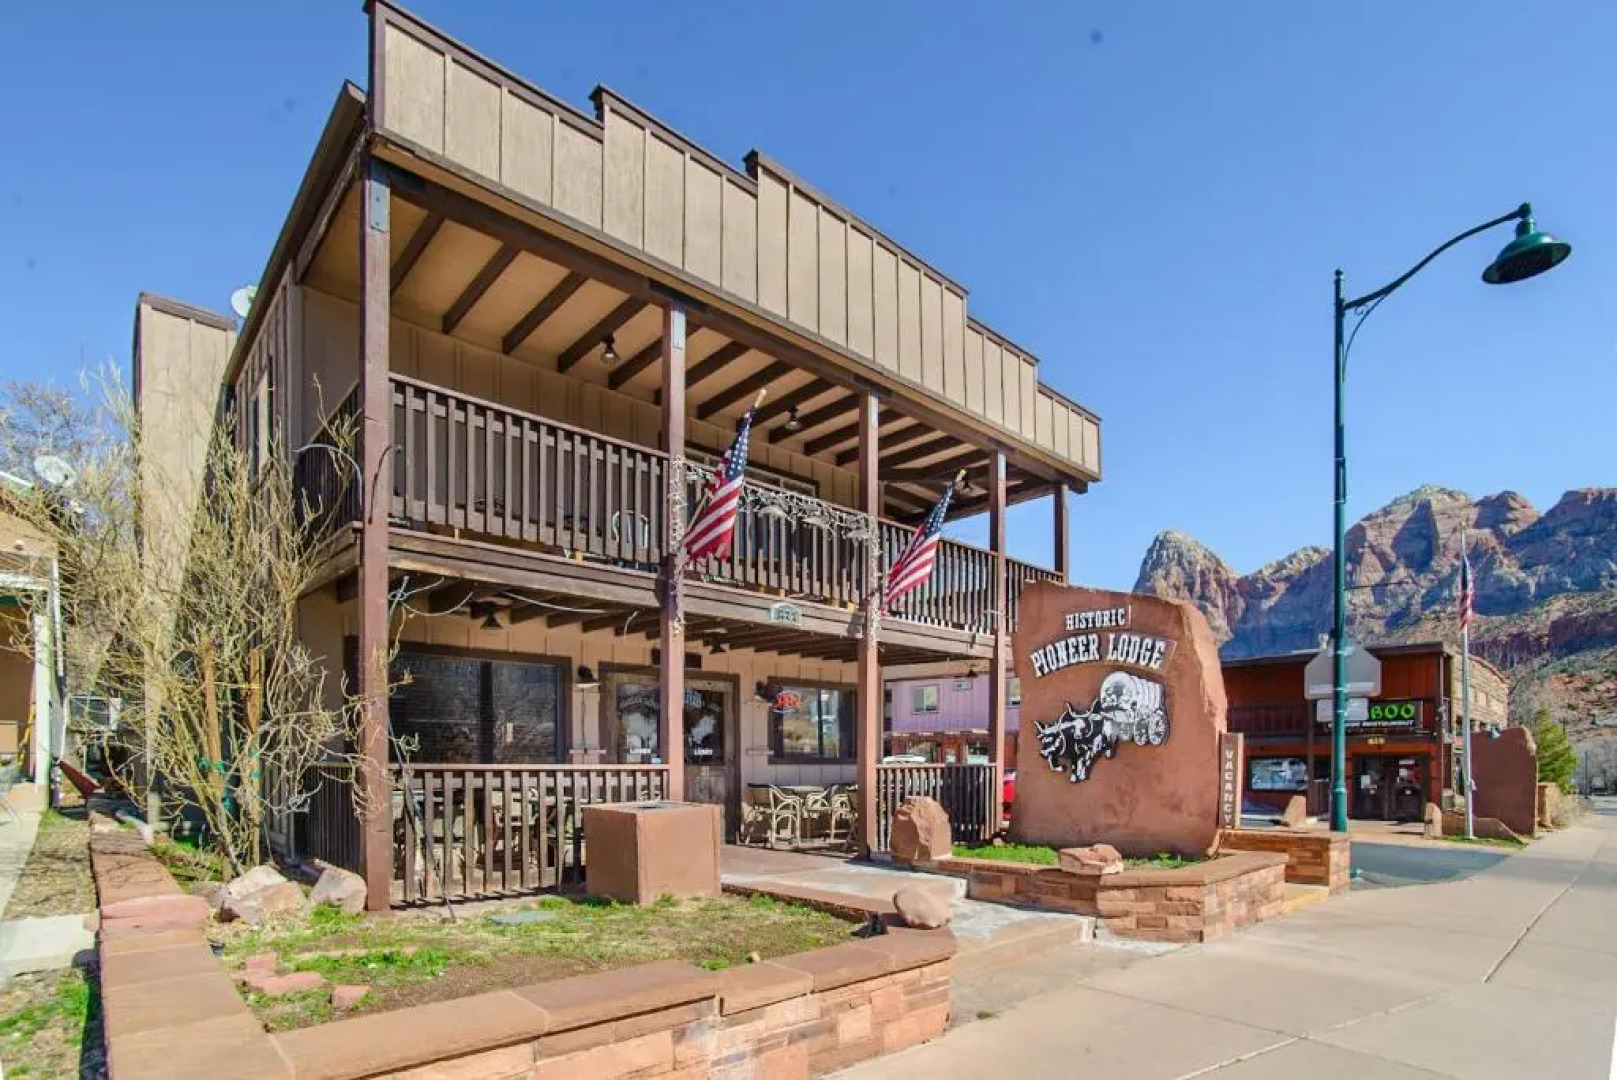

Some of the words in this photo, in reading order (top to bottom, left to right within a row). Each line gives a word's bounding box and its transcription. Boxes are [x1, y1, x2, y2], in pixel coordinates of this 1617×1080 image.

[1065, 607, 1125, 631] HISTORIC
[1030, 632, 1100, 678] PIONEER
[1106, 632, 1165, 670] LODGE
[1370, 703, 1416, 720] BOO
[1224, 749, 1234, 824] VACANCY
